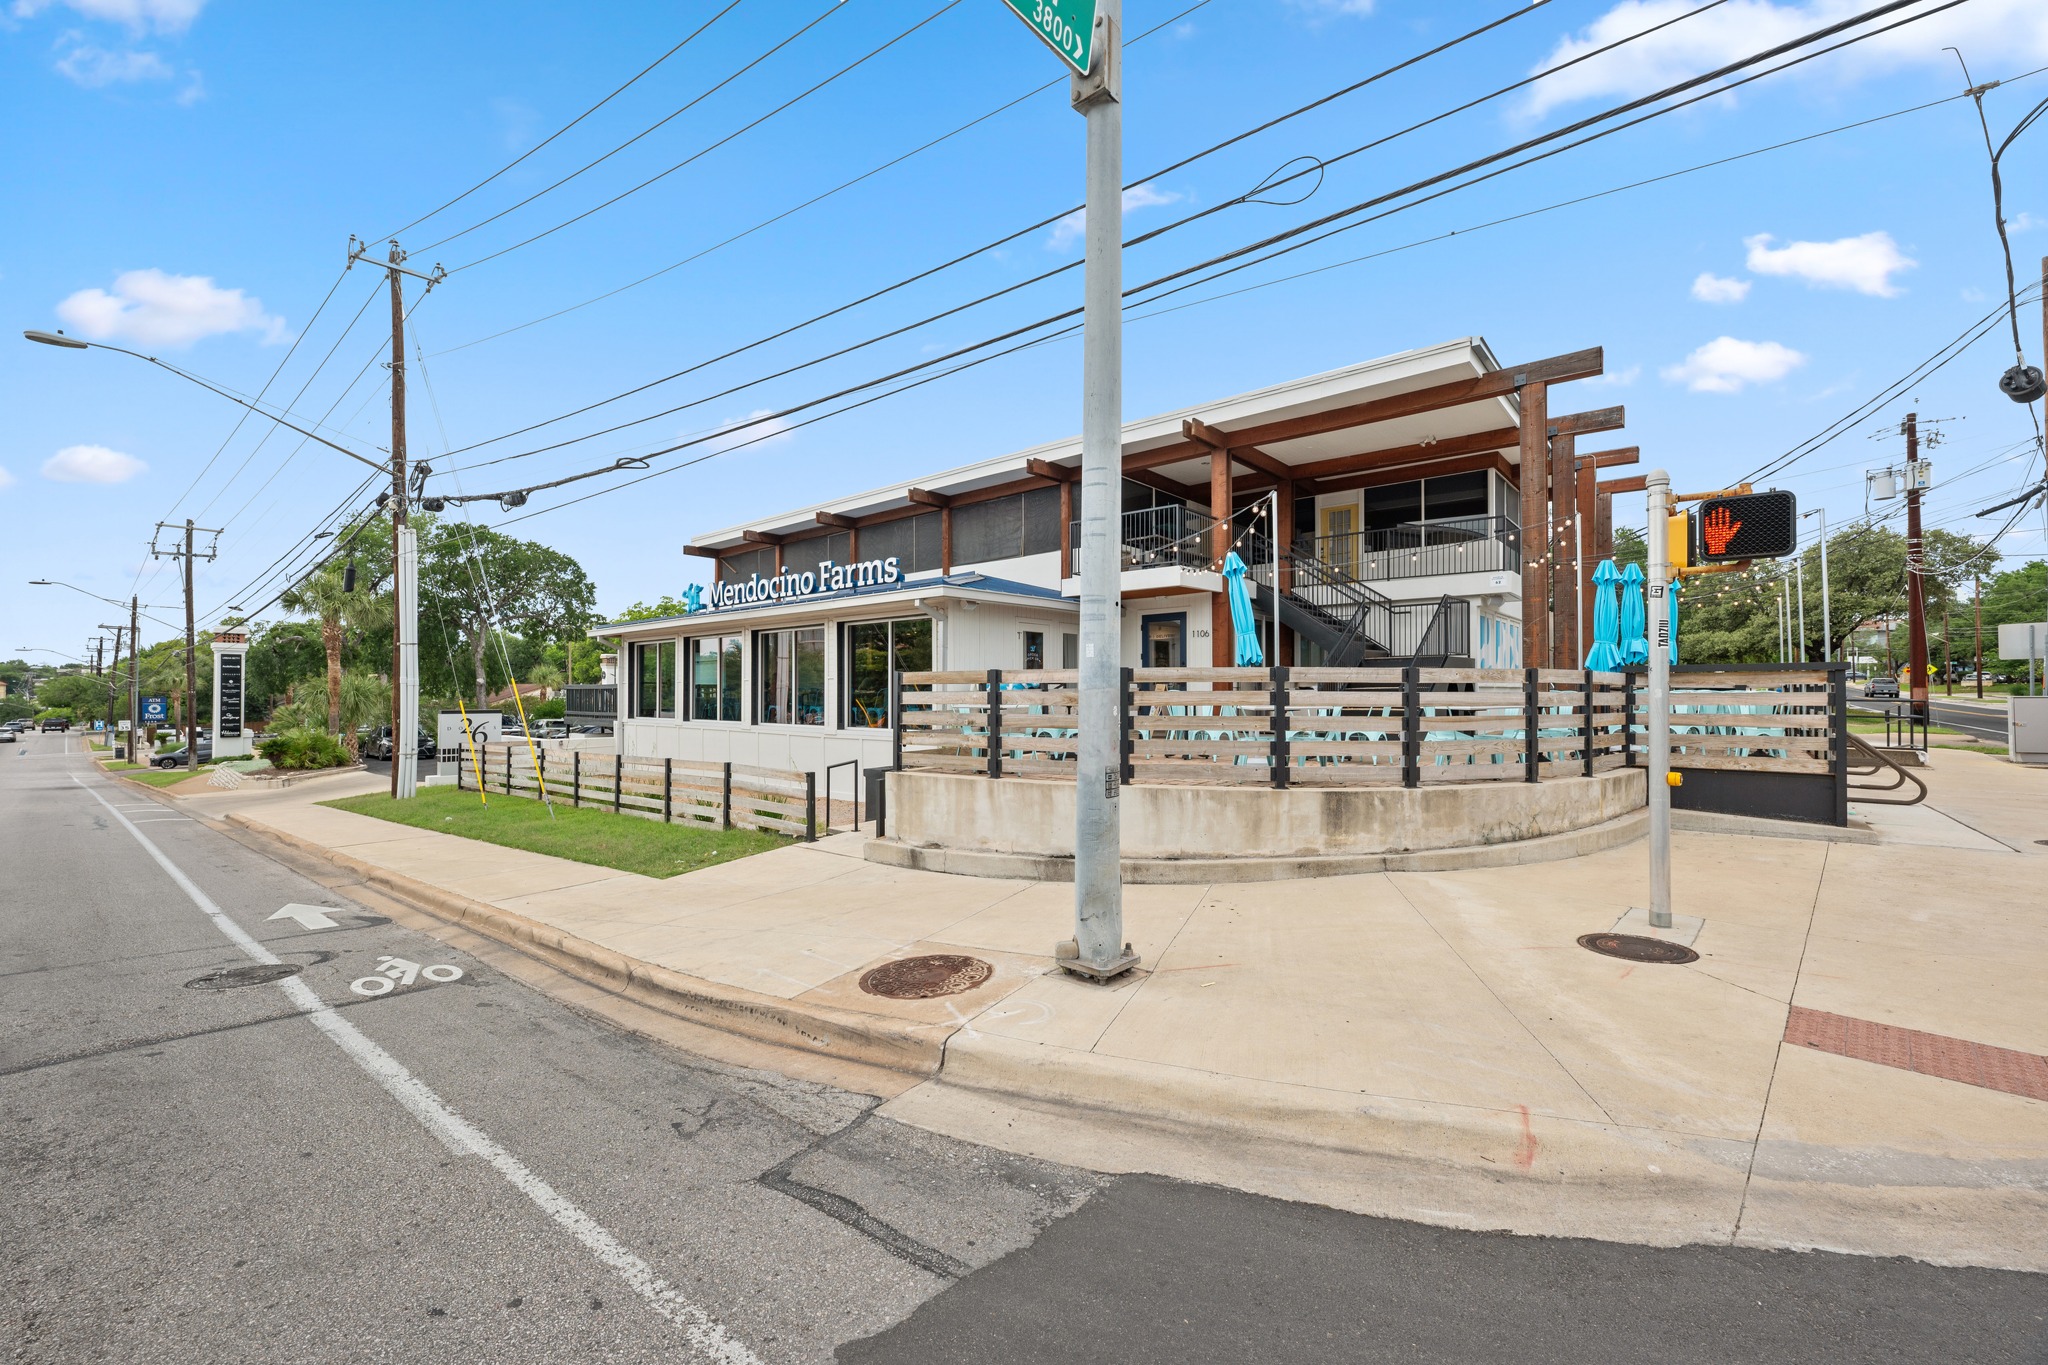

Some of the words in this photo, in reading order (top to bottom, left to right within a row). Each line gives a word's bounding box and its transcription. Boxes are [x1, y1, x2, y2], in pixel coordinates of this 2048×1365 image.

[1033, 0, 1073, 51] 3800
[708, 565, 816, 608] Mendocino
[818, 557, 901, 592] Farms
[1192, 630, 1210, 638] 1106
[460, 718, 490, 743] 26
